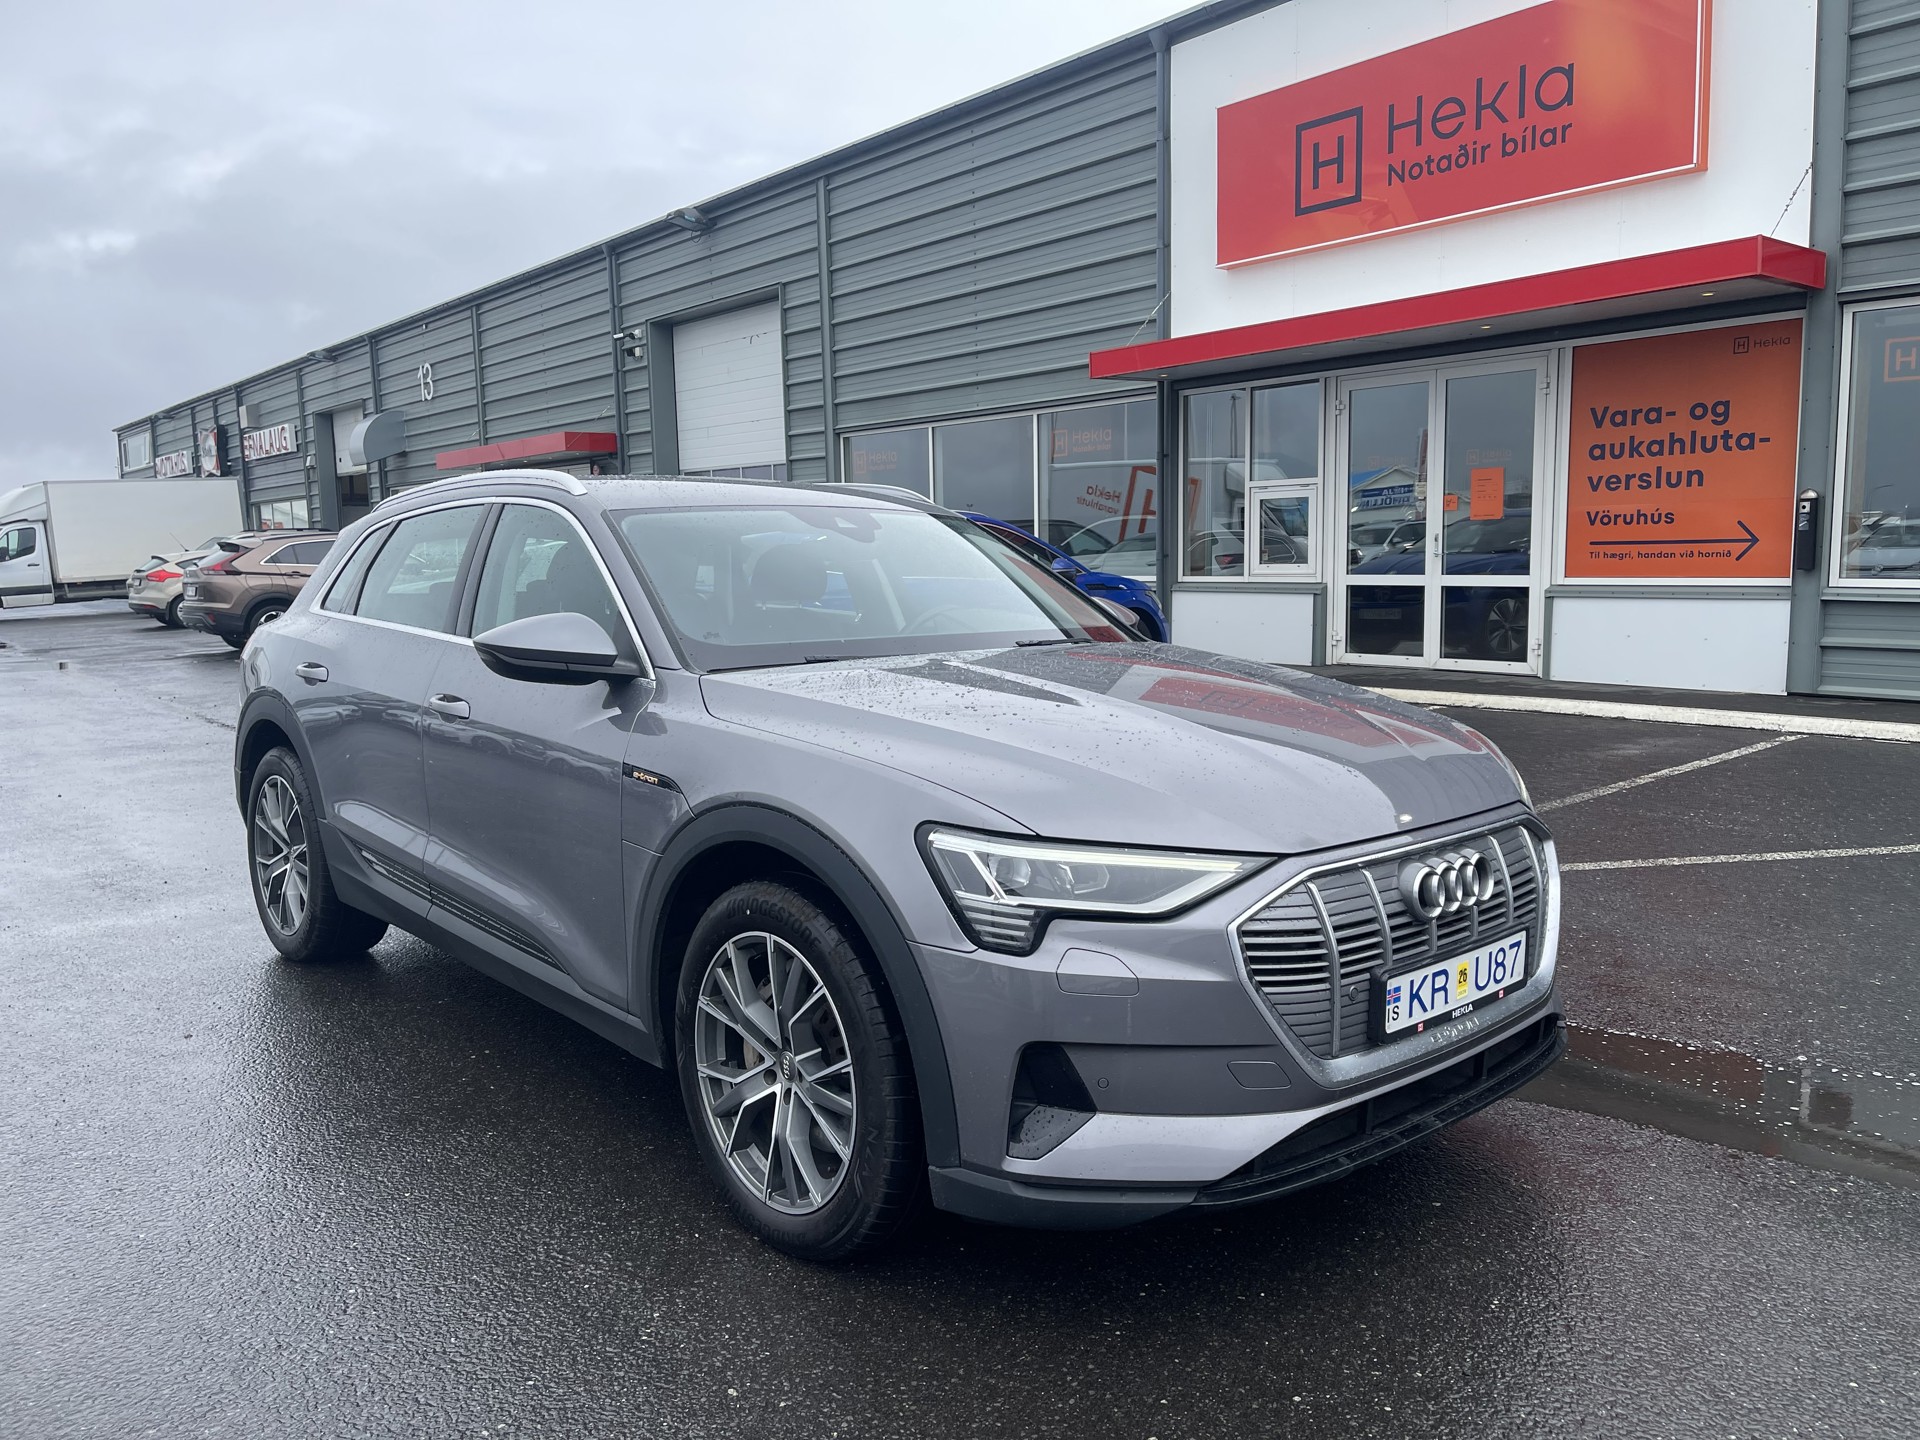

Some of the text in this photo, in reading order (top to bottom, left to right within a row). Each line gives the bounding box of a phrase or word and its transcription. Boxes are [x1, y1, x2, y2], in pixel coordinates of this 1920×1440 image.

[1387, 62, 1575, 154] Hekla
[1386, 122, 1574, 187] Notaðir bílar
[1753, 335, 1791, 350] Hekla
[417, 362, 435, 402] 13
[1589, 399, 1731, 430] Vara- og
[1072, 427, 1112, 443] Hekla
[1587, 429, 1771, 462] aukahluta-
[1587, 465, 1705, 493] verslun
[1586, 507, 1676, 527] Vöruhús
[1589, 549, 1732, 561] Til hægri, handan við hornið
[632, 771, 659, 785] e-tron
[1408, 968, 1450, 1019] KR
[1474, 940, 1522, 992] U87
[1387, 1004, 1400, 1024] IS
[1452, 1003, 1474, 1019] HEKLA
